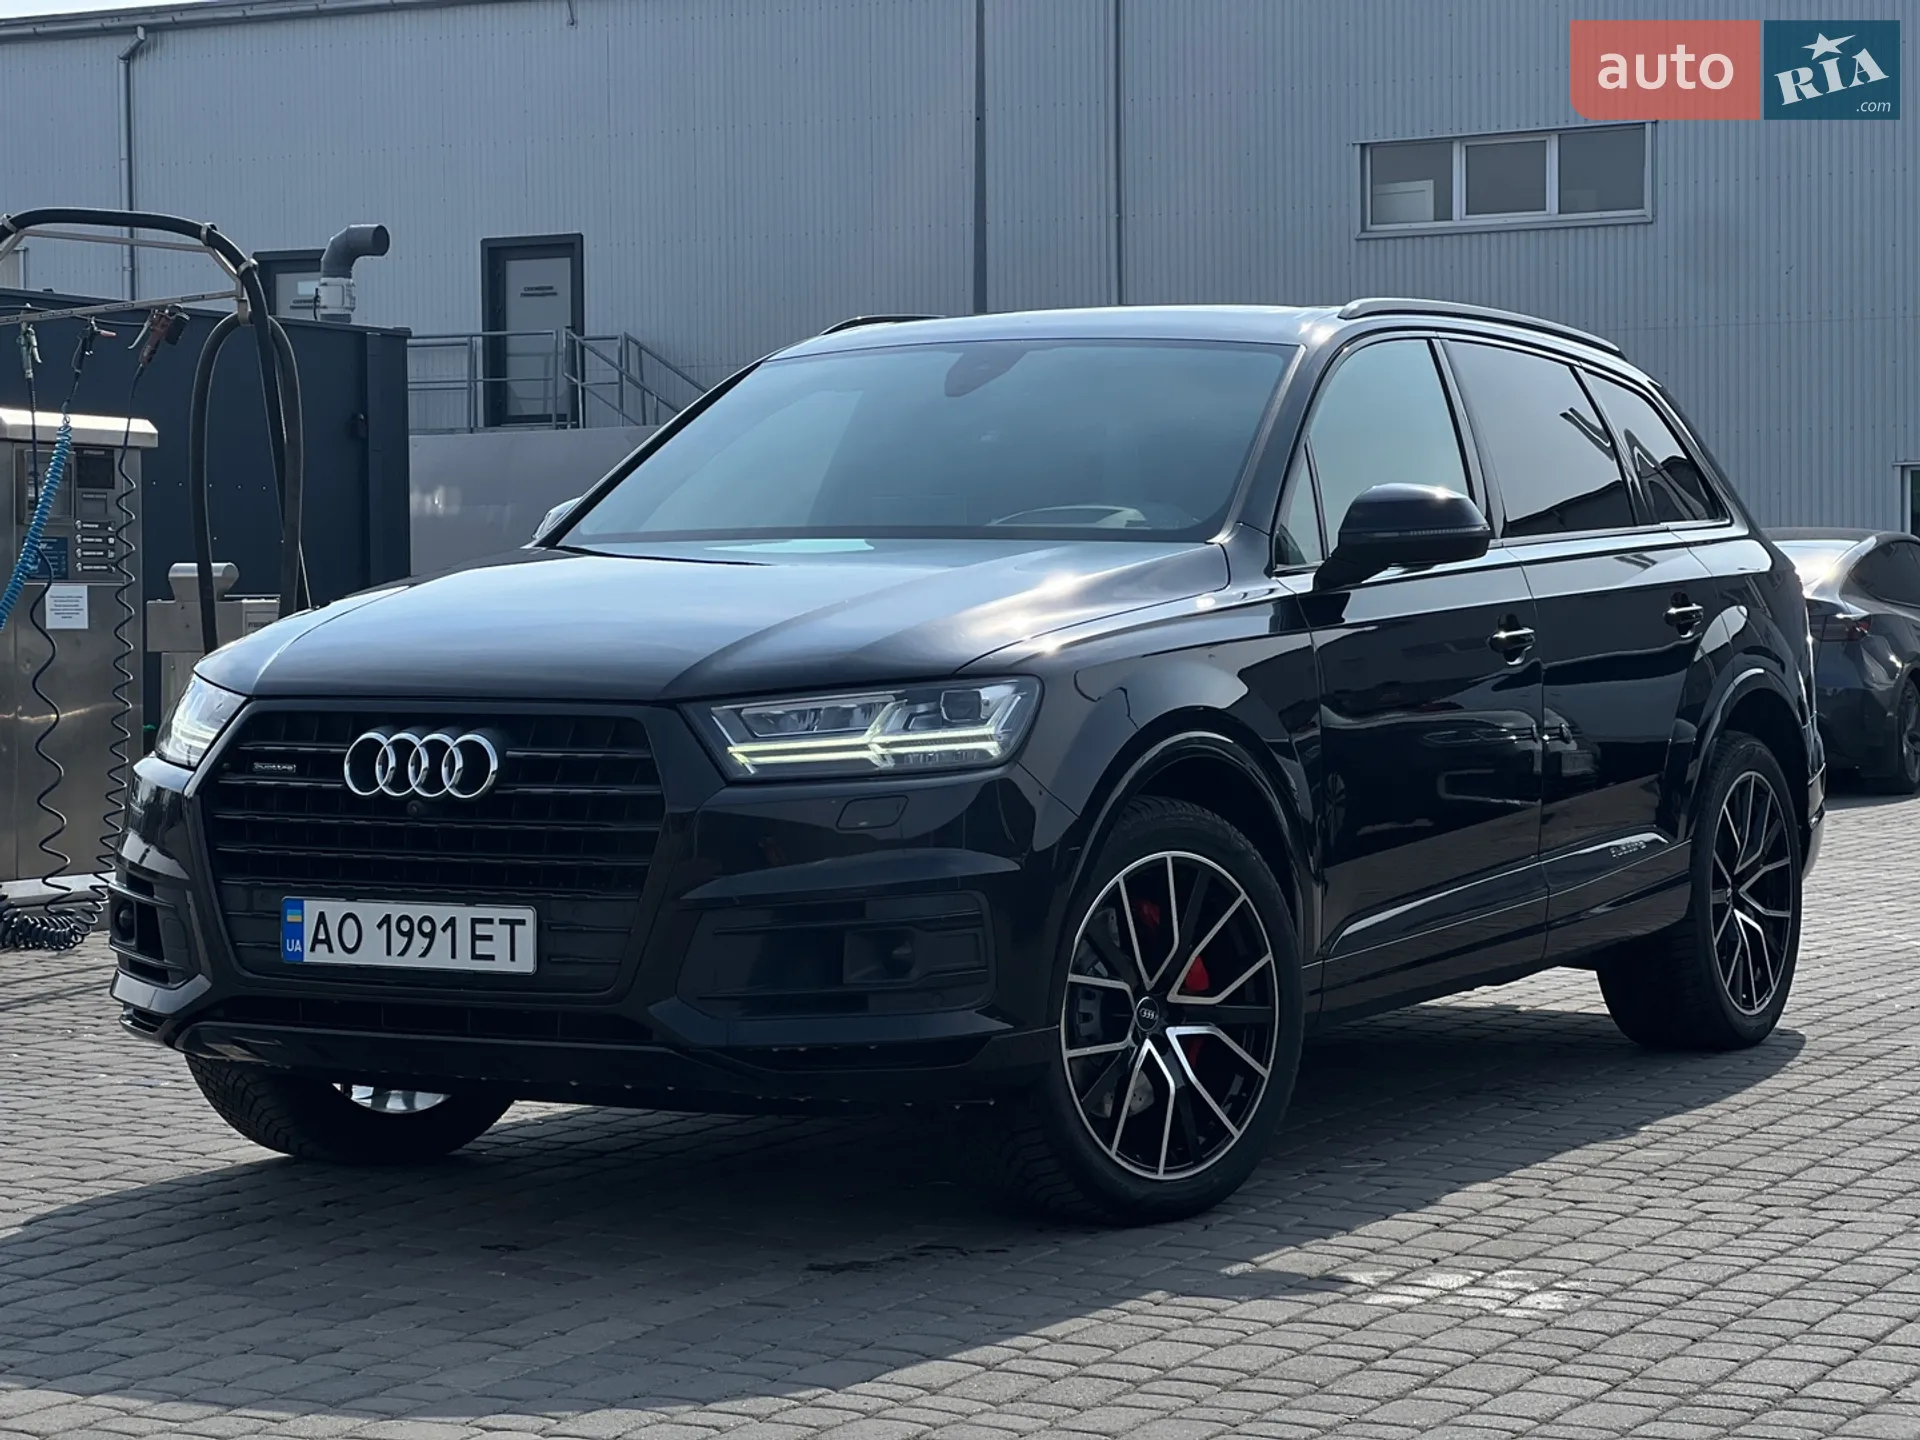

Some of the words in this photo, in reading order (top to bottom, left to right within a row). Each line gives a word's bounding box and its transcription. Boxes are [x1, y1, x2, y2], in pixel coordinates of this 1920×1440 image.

[286, 939, 302, 952] UA
[309, 910, 363, 955] AO
[376, 913, 457, 960] 1991
[470, 917, 526, 962] ET
